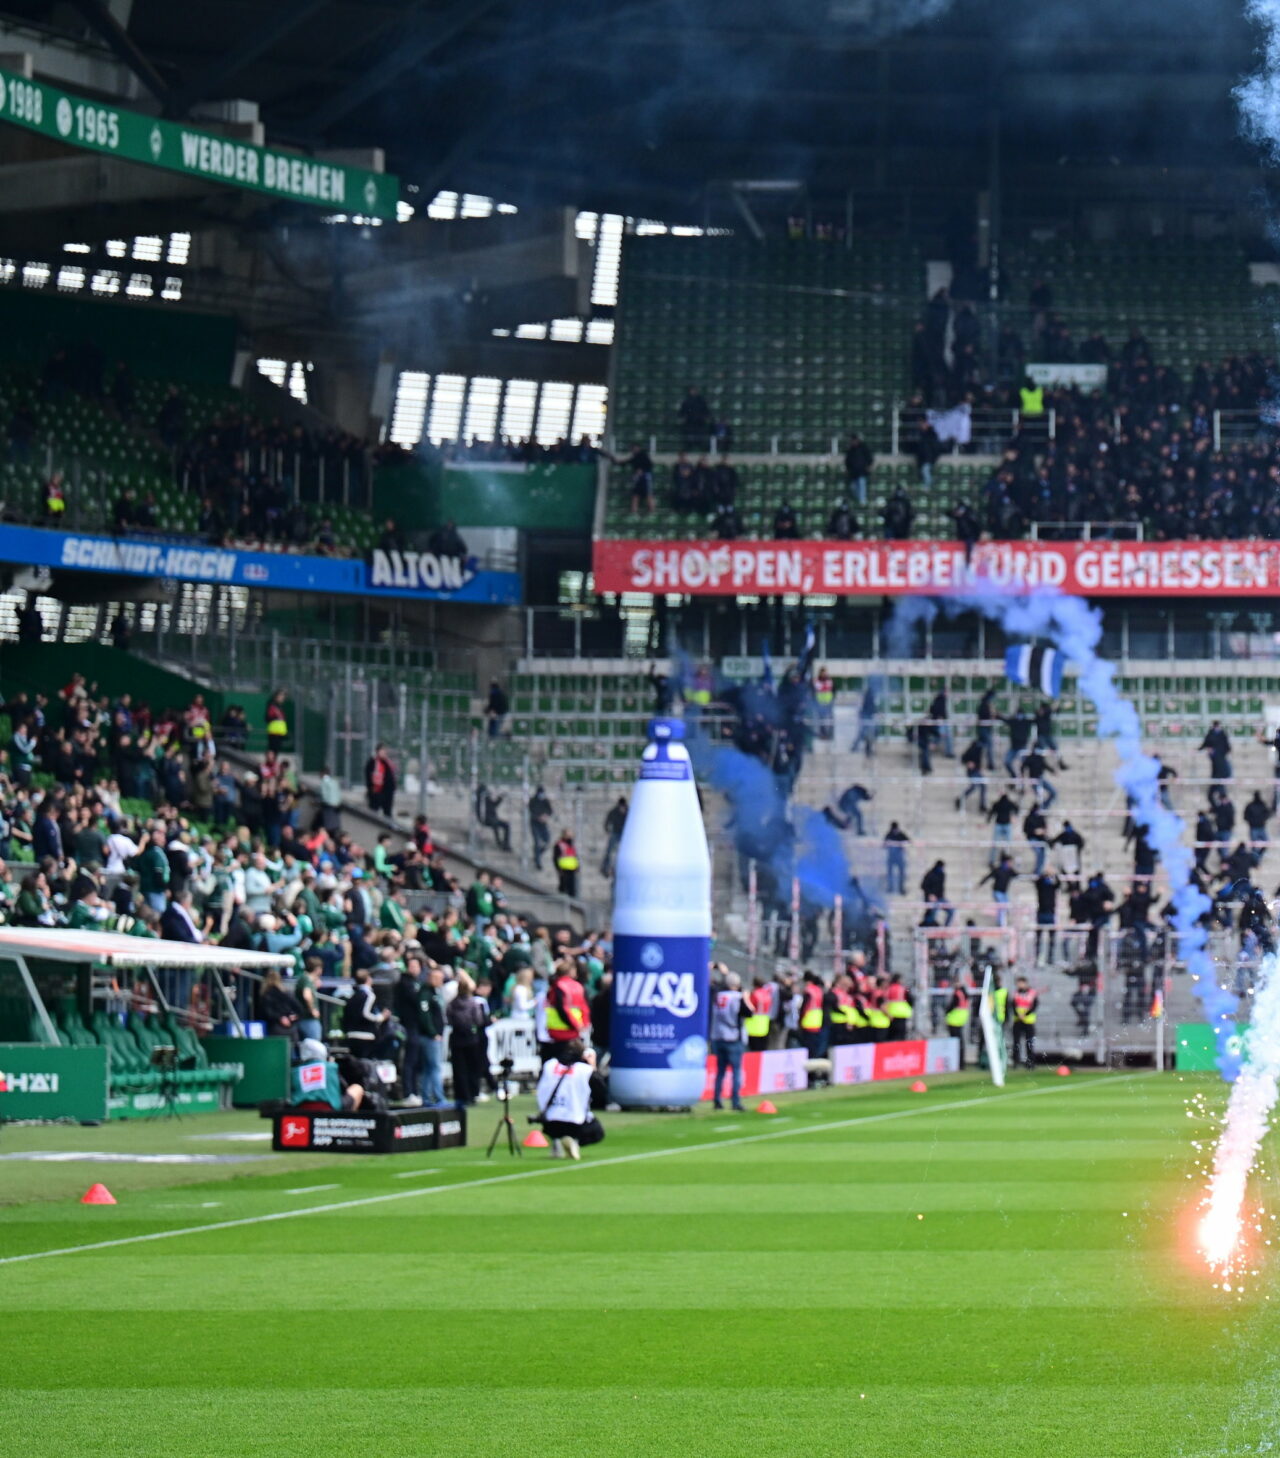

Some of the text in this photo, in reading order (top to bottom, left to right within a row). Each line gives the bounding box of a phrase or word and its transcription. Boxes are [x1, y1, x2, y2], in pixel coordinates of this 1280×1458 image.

[8, 79, 43, 125] 1988
[75, 104, 120, 149] 1965
[181, 131, 346, 203] WERDER BREMEN
[631, 550, 814, 592] SHOPPEN,
[824, 550, 976, 588] ERLEBEN
[989, 550, 1068, 588] UND
[1075, 550, 1269, 588] GENIESSEN
[615, 971, 699, 1018] VILSA
